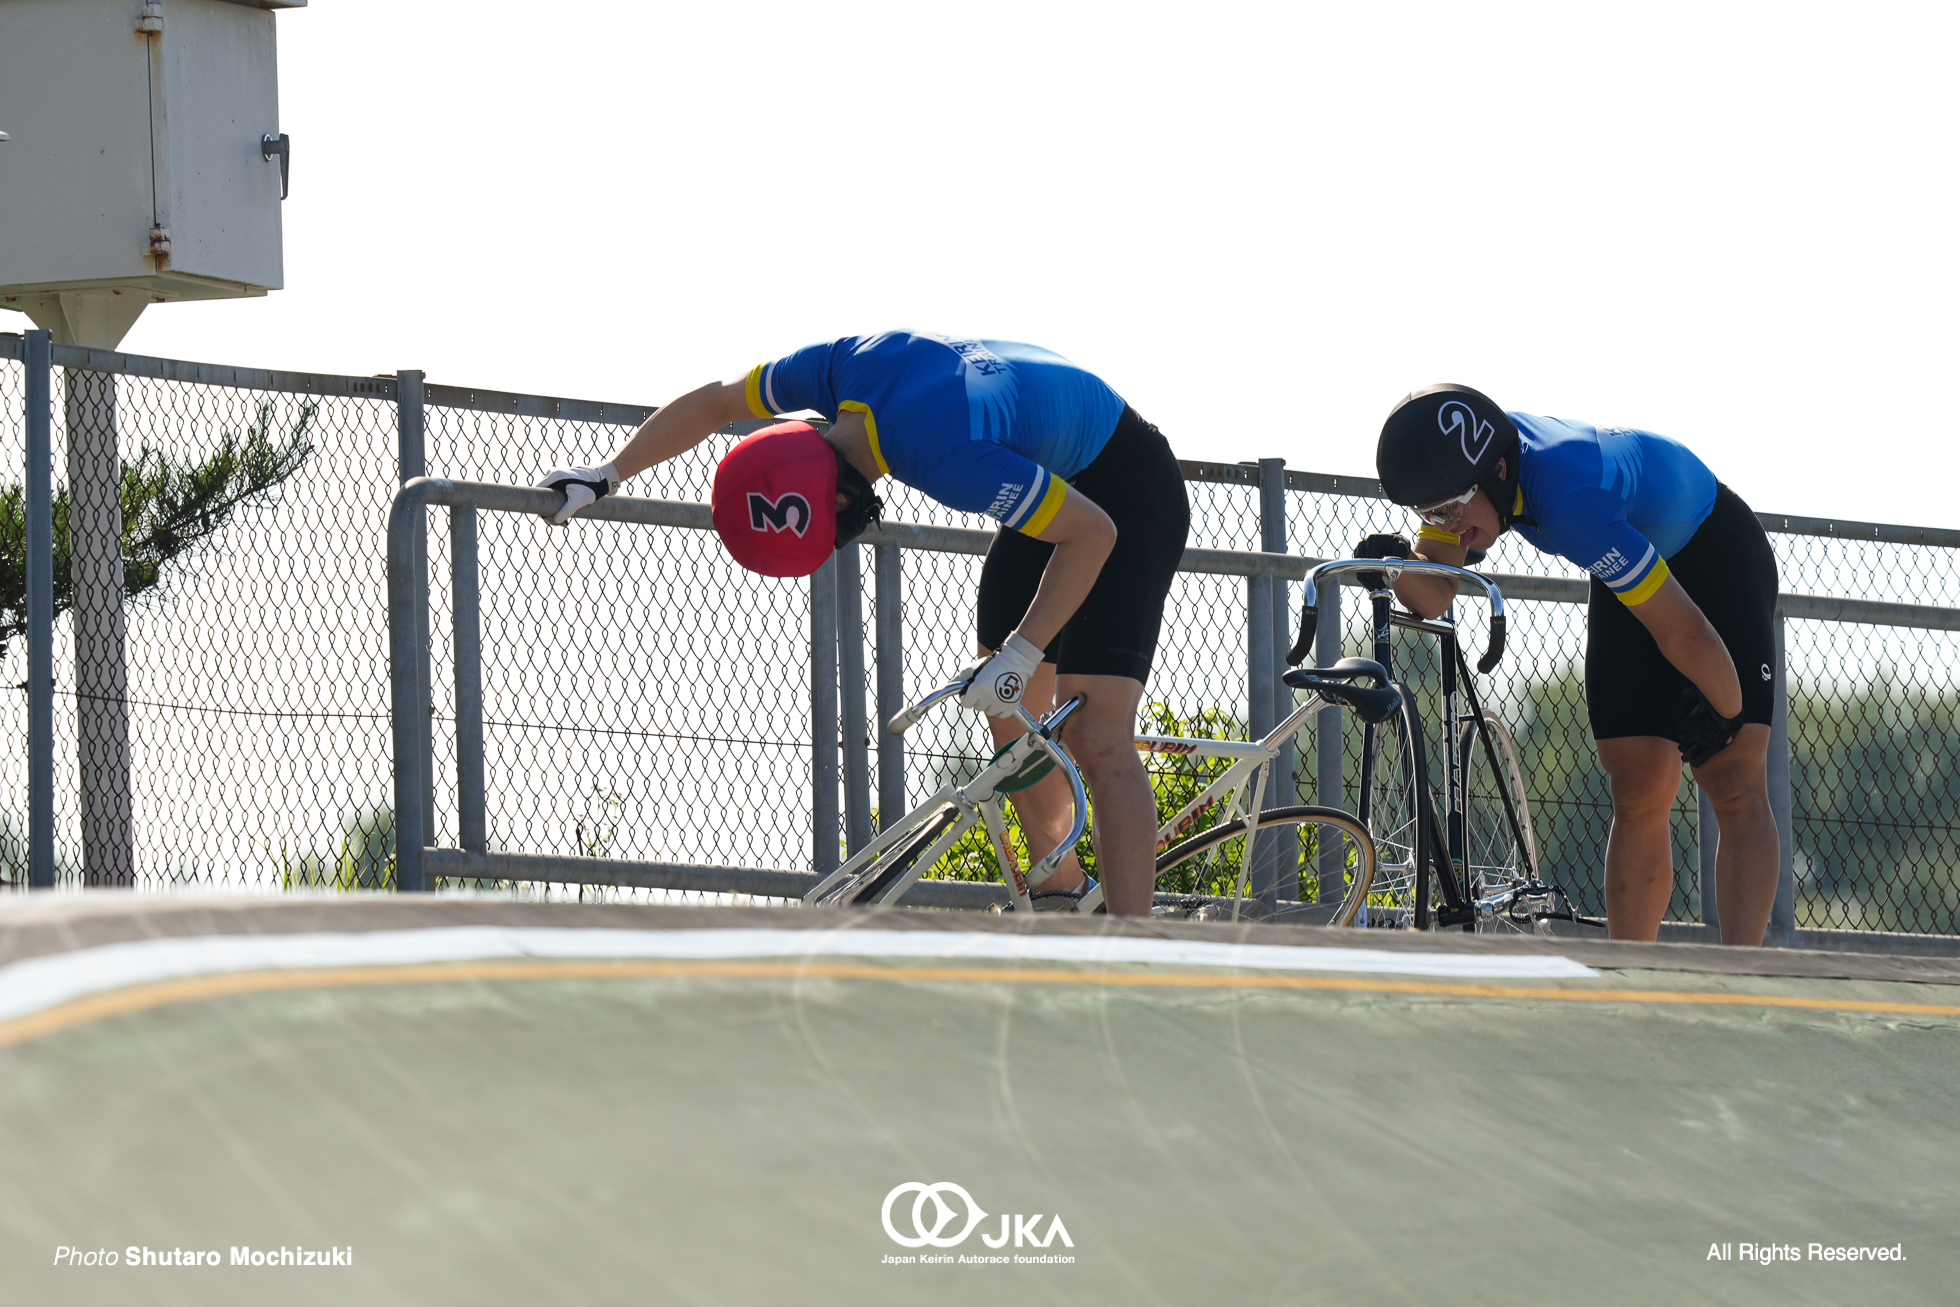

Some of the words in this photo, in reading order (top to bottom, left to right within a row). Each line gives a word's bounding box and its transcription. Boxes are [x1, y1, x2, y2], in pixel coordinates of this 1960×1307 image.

[1437, 400, 1495, 466] 2
[746, 491, 812, 539] 3
[984, 482, 1014, 516] EIRIN
[991, 483, 1024, 520] AINEE
[1587, 546, 1621, 575] EIRIN
[1596, 555, 1629, 579] AINEE
[1134, 740, 1198, 755] RUBIM
